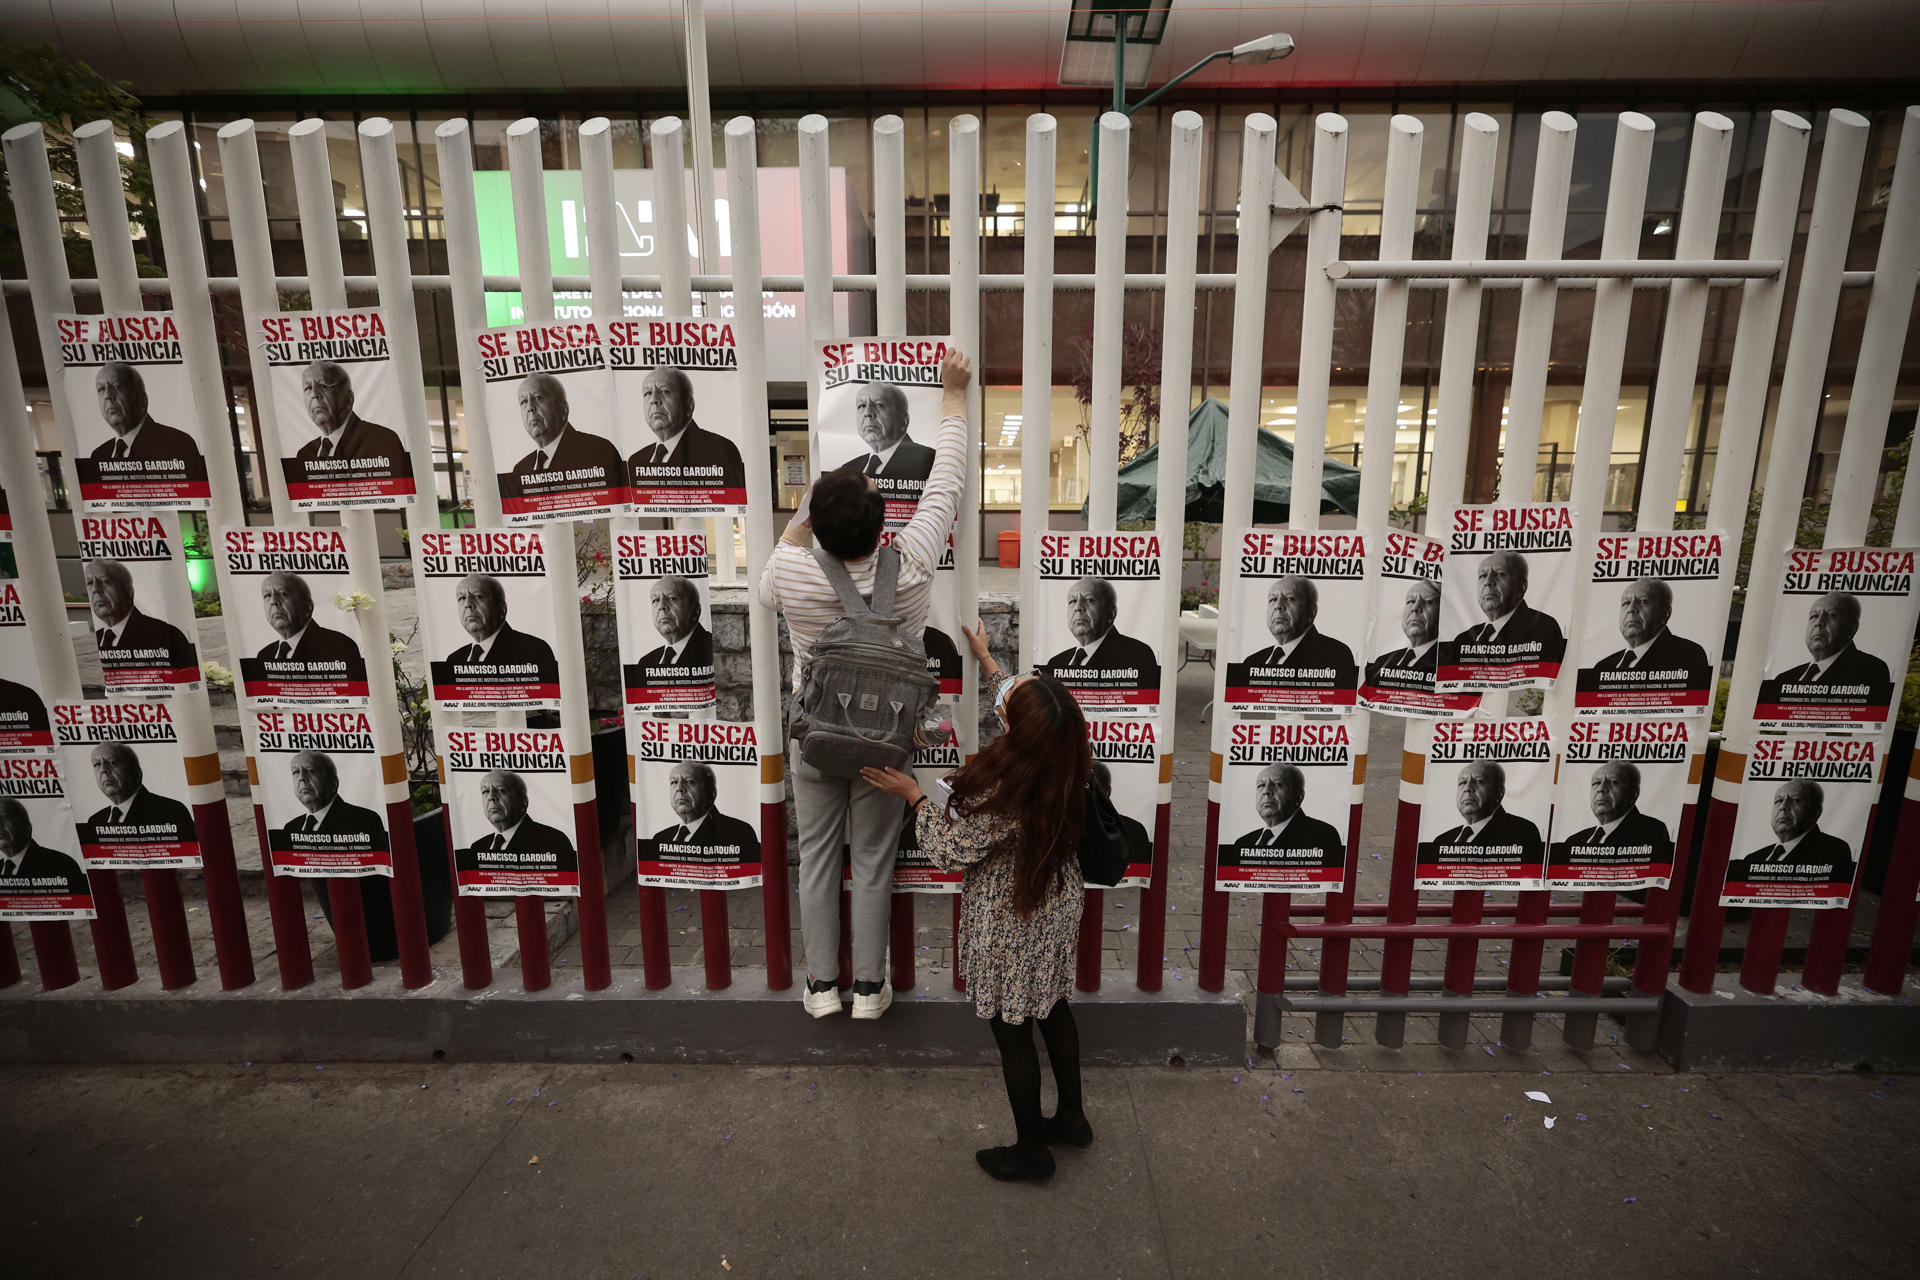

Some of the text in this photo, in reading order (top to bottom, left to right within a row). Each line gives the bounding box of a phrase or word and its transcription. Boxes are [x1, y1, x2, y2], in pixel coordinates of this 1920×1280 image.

[58, 317, 179, 342] SE BUSCA
[262, 313, 385, 342] SE BUSCA
[610, 322, 736, 347] SE BUSCA
[478, 323, 600, 358] SE BUSCA
[62, 341, 182, 362] SU RENUNCIA
[266, 338, 389, 361] SU RENUNCIA
[610, 347, 736, 365] SU RENUNCIA
[823, 342, 947, 368] SE BUSCA
[484, 346, 605, 377] SU RENUNCIA
[824, 366, 850, 385] SU
[98, 458, 185, 471] FRANCISCO GARDUÑO
[303, 456, 389, 471] FRANCISCO GARDUÑO
[635, 465, 723, 476] FRANCISCO GARDUÑO
[520, 466, 604, 485] FRANCISCO GARDUÑO
[1454, 508, 1572, 531] SE BUSCA
[82, 518, 167, 540] BUSCA
[80, 540, 172, 557] RENUNCIA
[226, 531, 346, 552] SE BUSCA
[422, 533, 544, 555] SE BUSCA
[617, 535, 707, 557] SE BUS
[1041, 536, 1160, 558] SE BUSCA
[1243, 534, 1365, 557] SE BUSCA
[1386, 534, 1418, 558] SE
[1451, 530, 1572, 550] SU RENUNCIA
[1597, 536, 1721, 560] SE BUSCA
[228, 553, 348, 569] SU RENUNCIA
[423, 555, 544, 572] SU RENUNCIA
[618, 557, 709, 574] SU RENUN
[1040, 558, 1159, 575] SU RENUNCIA
[1241, 556, 1363, 574] SU RENUNCIA
[1382, 556, 1407, 574] SU
[1593, 558, 1719, 577] SU RENUNCIA
[1790, 552, 1914, 573] SE BUSCA
[1785, 573, 1910, 590] SU RENUNCIA
[99, 649, 131, 659] ANCISCO
[1460, 641, 1543, 654] FRANCISCO GARDUÑO
[264, 660, 346, 671] FRANCISCO GARDUÑO
[453, 663, 538, 674] FRANCISCO GARDUÑO
[646, 668, 689, 677] FRANCISCO
[1053, 668, 1138, 678] FRANCISCO GARDUÑO
[1249, 667, 1336, 678] FRANCISCO GARDUÑO
[1380, 668, 1424, 680] FRANCISCO
[1599, 668, 1688, 681] FRANCISCO GARDUÑO
[1781, 684, 1870, 694] FRANCISCO GARDUÑO
[54, 704, 172, 724] SE BUSCA
[57, 723, 176, 740] SU RENUNCIA
[257, 713, 371, 733] SE BUSCA
[1434, 721, 1550, 742] SE BUSCA
[260, 733, 373, 748] SU RENUNCIA
[642, 721, 757, 746] SE BUSCA
[1232, 725, 1349, 745] SE BUSCA
[1570, 722, 1688, 742] SE BUSCA
[448, 732, 564, 752] SE BUSCA
[1090, 742, 1154, 759] NUNCIA
[1432, 742, 1550, 758] SU RENUNCIA
[1567, 743, 1685, 758] SU RENUNCIA
[641, 742, 756, 761] SU RENUNCIA
[1230, 746, 1347, 761] SU RENUNCIA
[1754, 741, 1874, 761] SE BUSCA
[450, 752, 565, 768] SU RENUNCIA
[0, 759, 59, 779] USCA
[1749, 761, 1872, 777] SU RENUNCIA
[0, 780, 64, 794] NUNCIA
[95, 823, 177, 834] FRANCISCO GARDUÑO
[290, 833, 370, 842] FRANCISCO GARDUÑO
[477, 852, 556, 861] FRANCISCO GARDUÑO
[659, 844, 739, 854] FRANCISCO GARDUÑO
[1240, 847, 1323, 857] FRANCISCO GARDUÑO
[1438, 844, 1522, 854] FRANCISCO GARDUÑO
[1571, 844, 1653, 855] FRANCISCO GARDUÑO
[1749, 863, 1833, 873] FRANCISCO GARDUÑO
